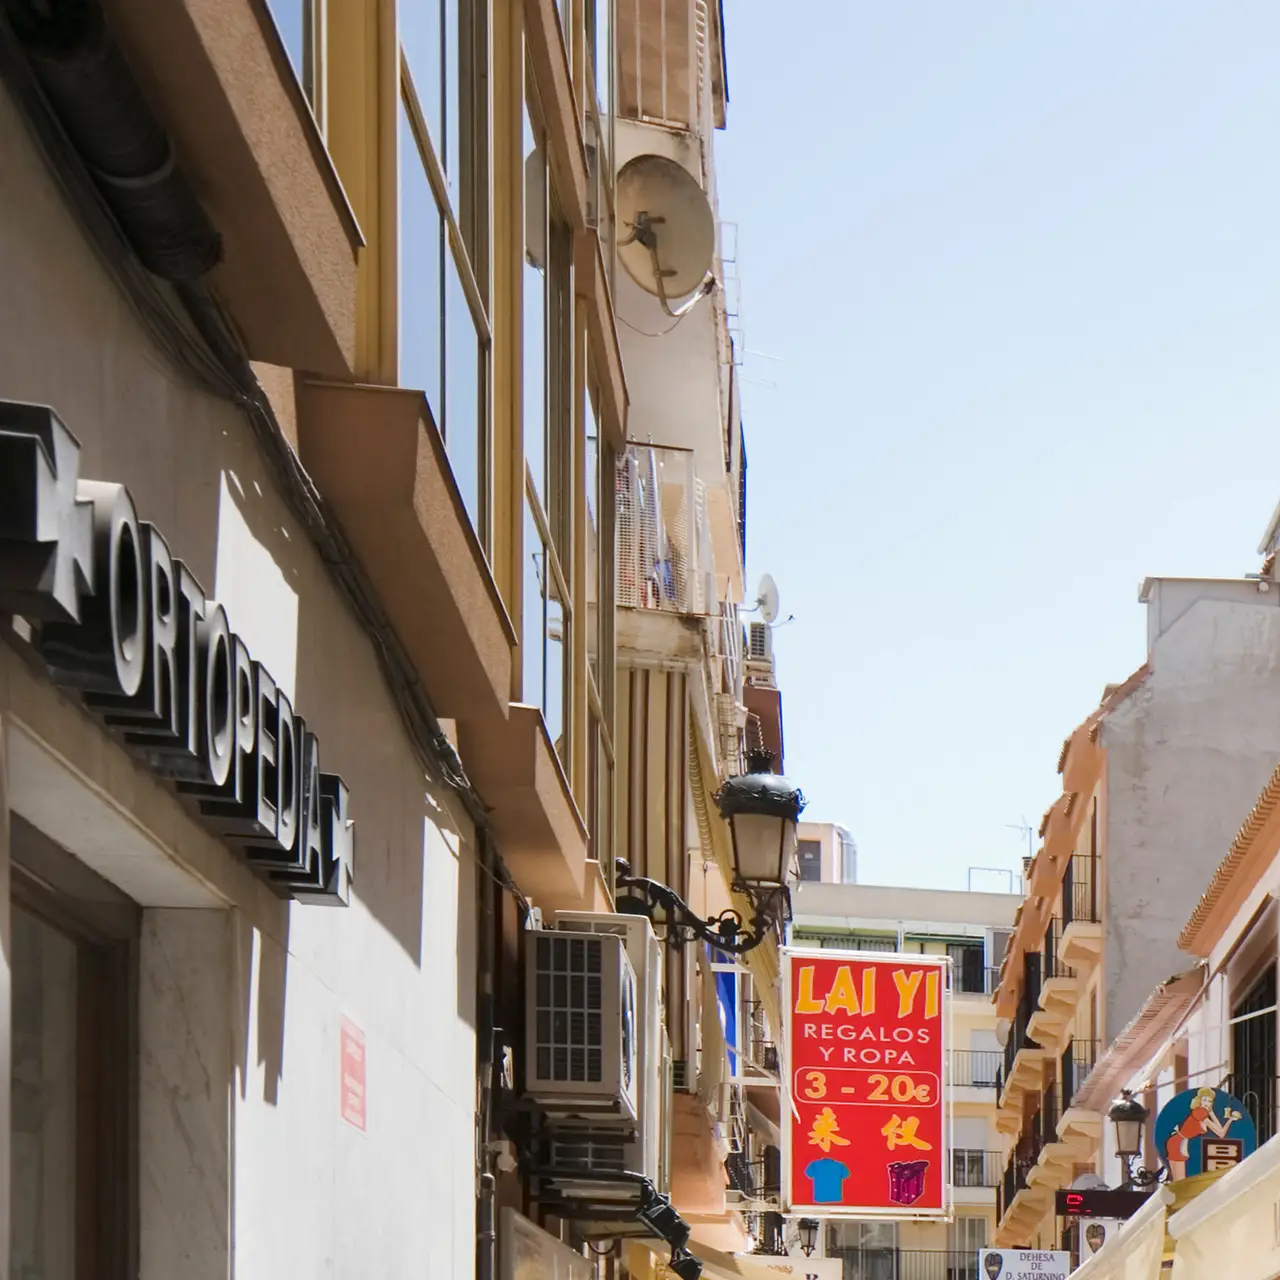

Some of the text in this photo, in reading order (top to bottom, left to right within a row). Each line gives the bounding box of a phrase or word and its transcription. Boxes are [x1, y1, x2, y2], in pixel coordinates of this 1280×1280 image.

[108, 484, 325, 890] ORTOPEDIA
[795, 964, 940, 1020] LAI YI
[804, 1023, 931, 1044] REGALOS
[819, 1046, 916, 1066] Y ROPA
[804, 1071, 828, 1099] 3
[867, 1073, 932, 1103] 20€
[1019, 1252, 1056, 1262] DEHESA
[1031, 1262, 1043, 1271] DE
[1005, 1271, 1015, 1280] D.
